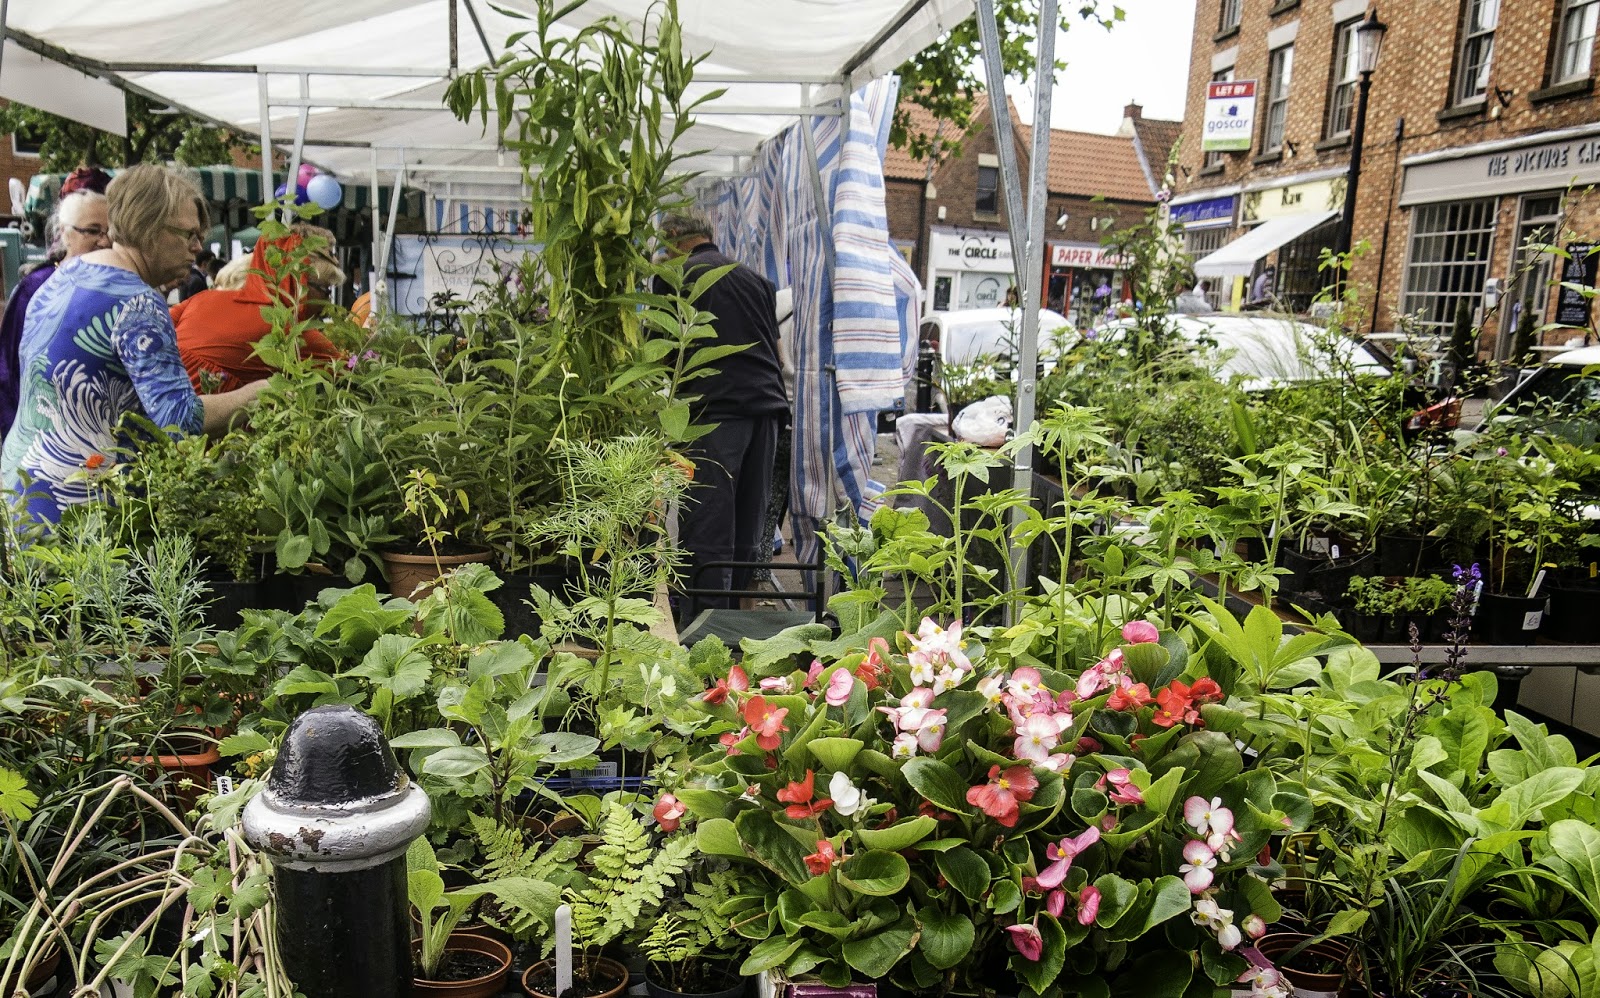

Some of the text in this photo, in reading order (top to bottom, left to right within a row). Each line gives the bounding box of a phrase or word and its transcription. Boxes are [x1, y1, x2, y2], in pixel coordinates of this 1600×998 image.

[1215, 84, 1247, 97] LET BY
[1208, 119, 1249, 133] goscar
[1487, 155, 1509, 177] THE
[1515, 145, 1570, 173] PICTURE
[1281, 187, 1304, 206] Raw
[948, 248, 960, 256] THE
[965, 247, 998, 259] CIRCLE
[1058, 249, 1092, 265] PAPER
